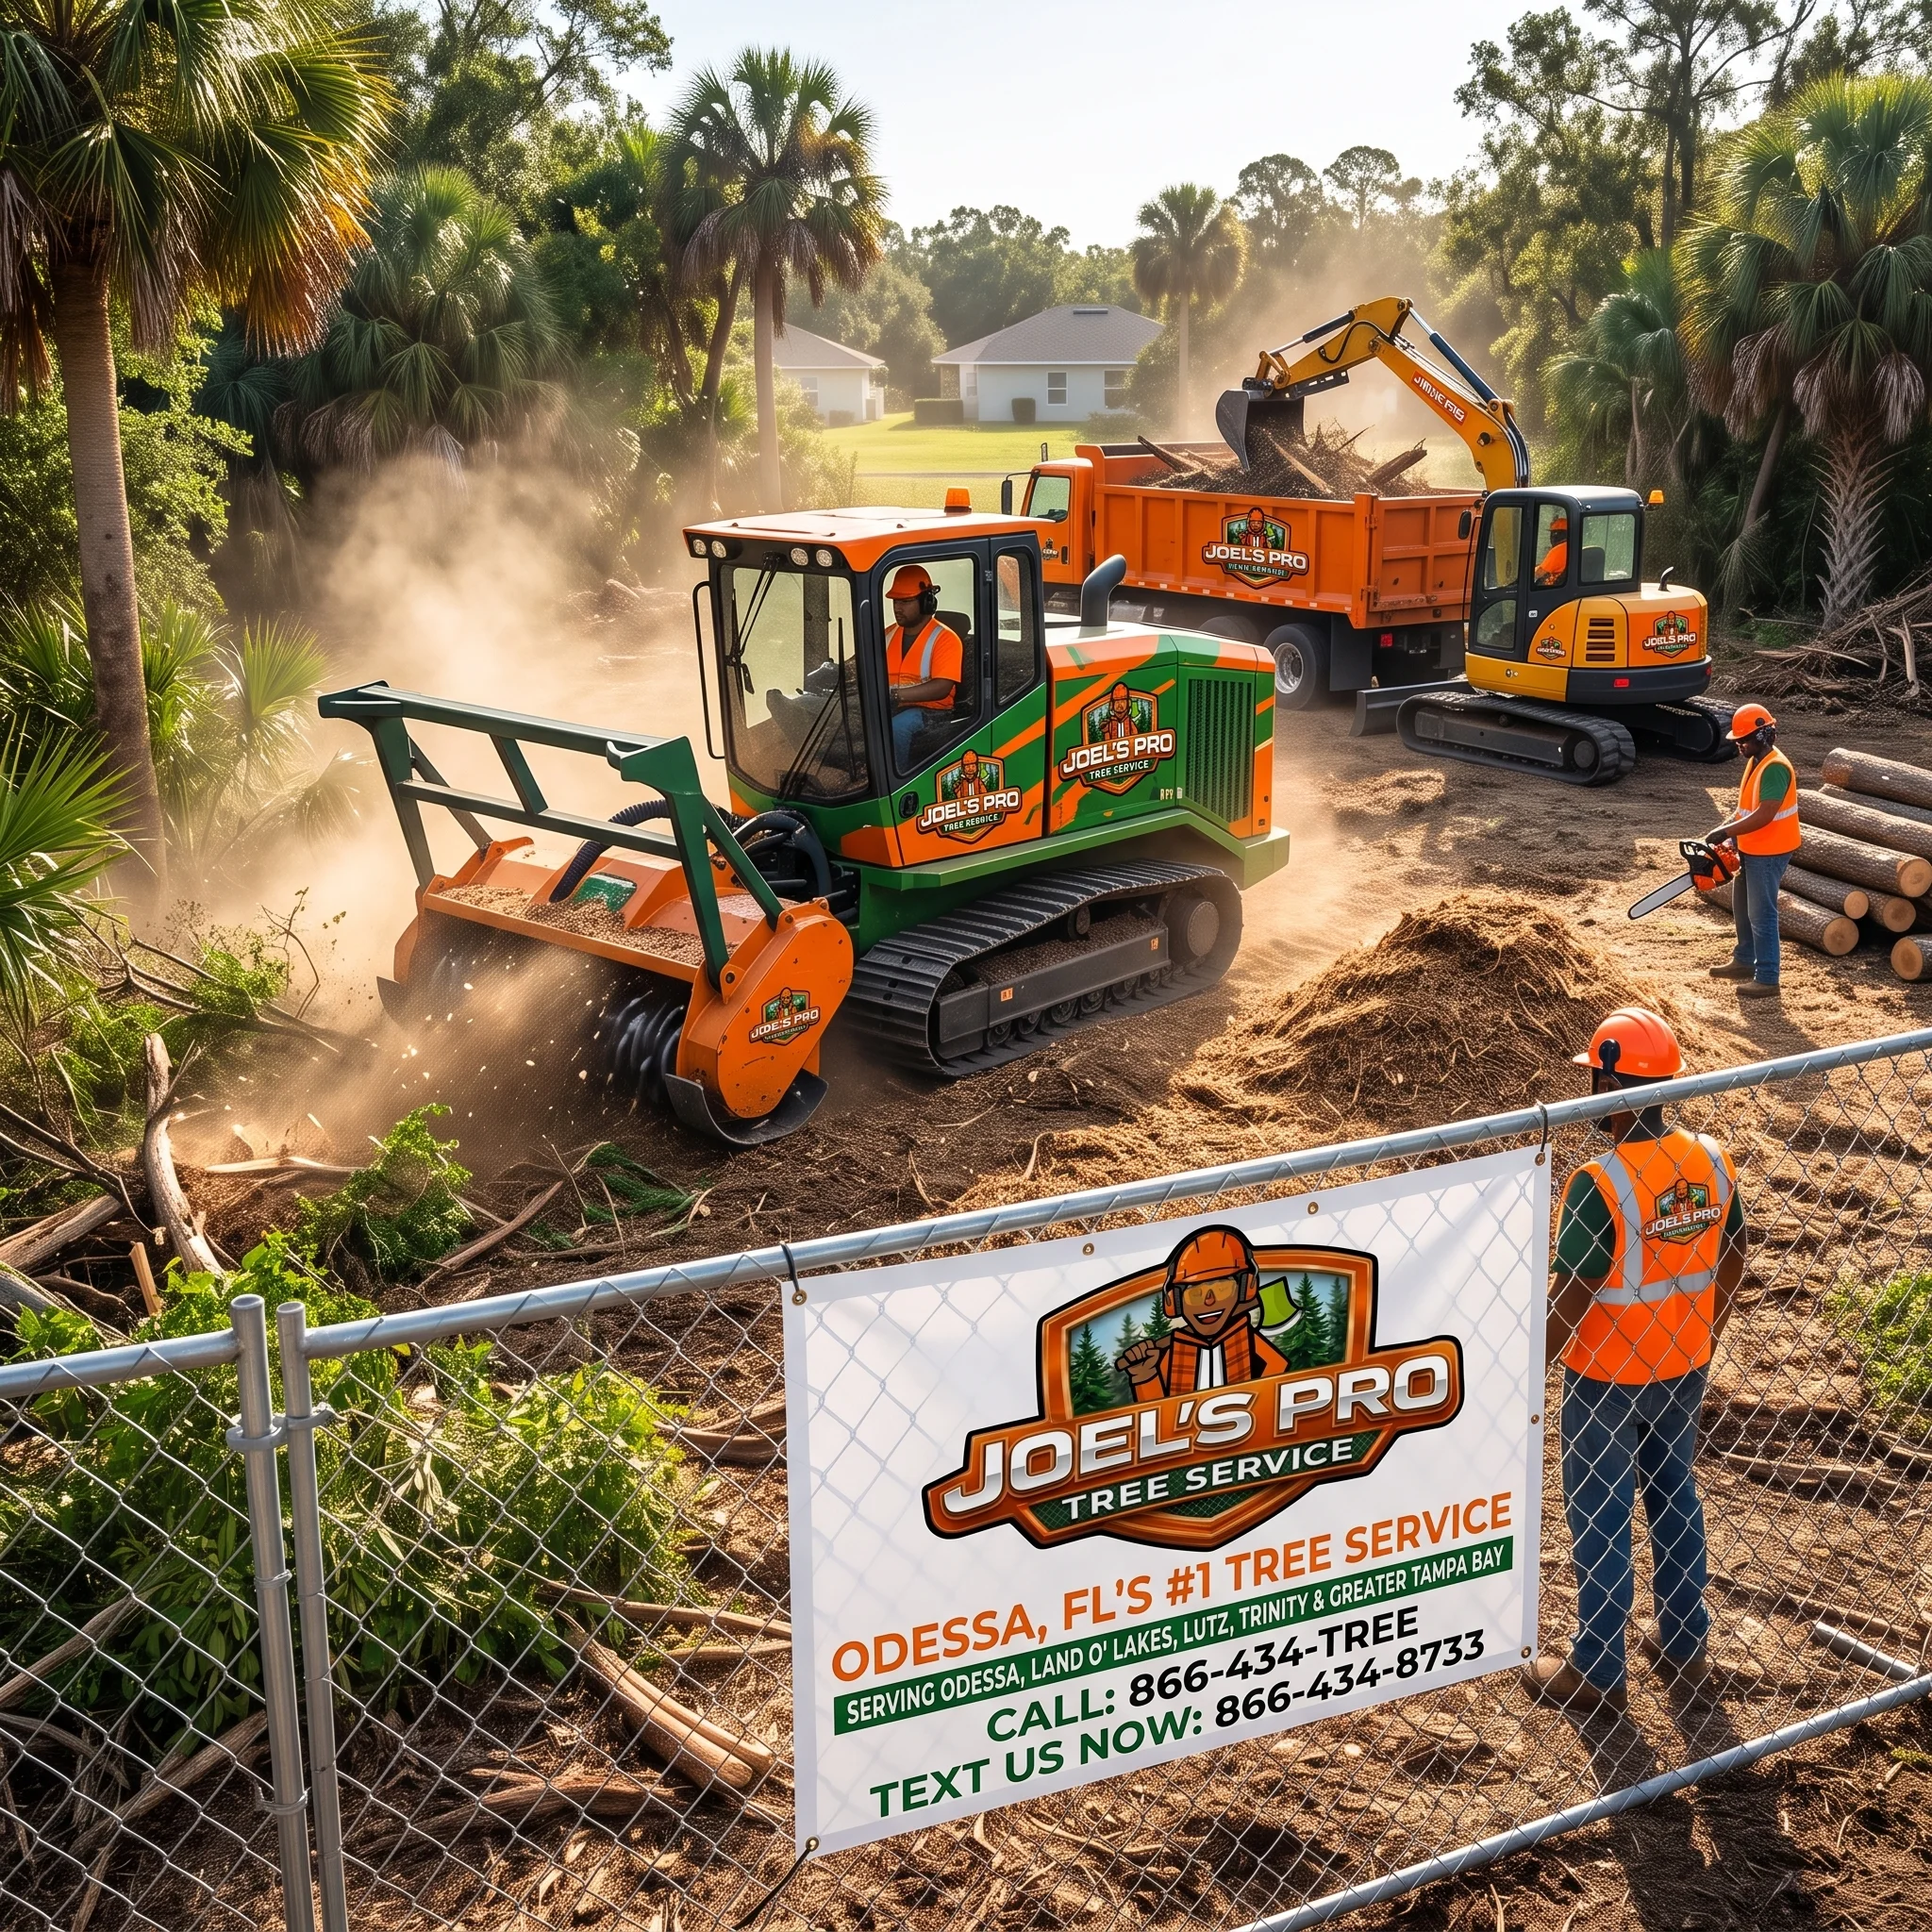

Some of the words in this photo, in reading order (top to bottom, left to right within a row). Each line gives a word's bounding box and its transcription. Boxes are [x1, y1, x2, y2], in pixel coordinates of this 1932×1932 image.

[1205, 545, 1265, 563] JOEL'S
[1269, 552, 1306, 569] PRO
[1062, 740, 1129, 774] JOEL'S
[1134, 733, 1173, 756] PRO
[1090, 768, 1111, 780] TREE
[1113, 759, 1149, 774] SERVICE
[921, 797, 980, 827] JOEL'S
[983, 791, 1019, 811] PRO
[1692, 1208, 1722, 1222] PRO
[943, 1393, 1253, 1515] JOEL'S
[1278, 1351, 1450, 1433] PRO
[1061, 1481, 1169, 1522] TREE
[1186, 1439, 1354, 1493] SERVICE
[832, 1603, 1048, 1682] ODESSA,
[1063, 1575, 1153, 1630] FL'S
[1165, 1561, 1211, 1606] #1
[1224, 1533, 1332, 1592] TREE
[1344, 1491, 1512, 1563] SERVICE
[847, 1682, 935, 1725] SERVING
[940, 1661, 1025, 1702] ODESSA,
[1030, 1646, 1084, 1682] LAND
[1088, 1641, 1108, 1666] O'
[1112, 1624, 1178, 1661] LAKES,
[1182, 1611, 1235, 1644] LUTZ,
[1239, 1592, 1308, 1630] TRINITY
[1312, 1588, 1325, 1612] &
[1329, 1568, 1407, 1608] GREATER
[1411, 1555, 1468, 1588] TAMPA
[1472, 1544, 1505, 1573] BAY
[986, 1688, 1116, 1742] CALL:
[1128, 1605, 1420, 1707] 866-434-TREE
[870, 1757, 991, 1818] TEXT
[1005, 1740, 1065, 1783] US
[1080, 1705, 1203, 1765] NOW:
[1214, 1628, 1485, 1728] 866-434-8733
